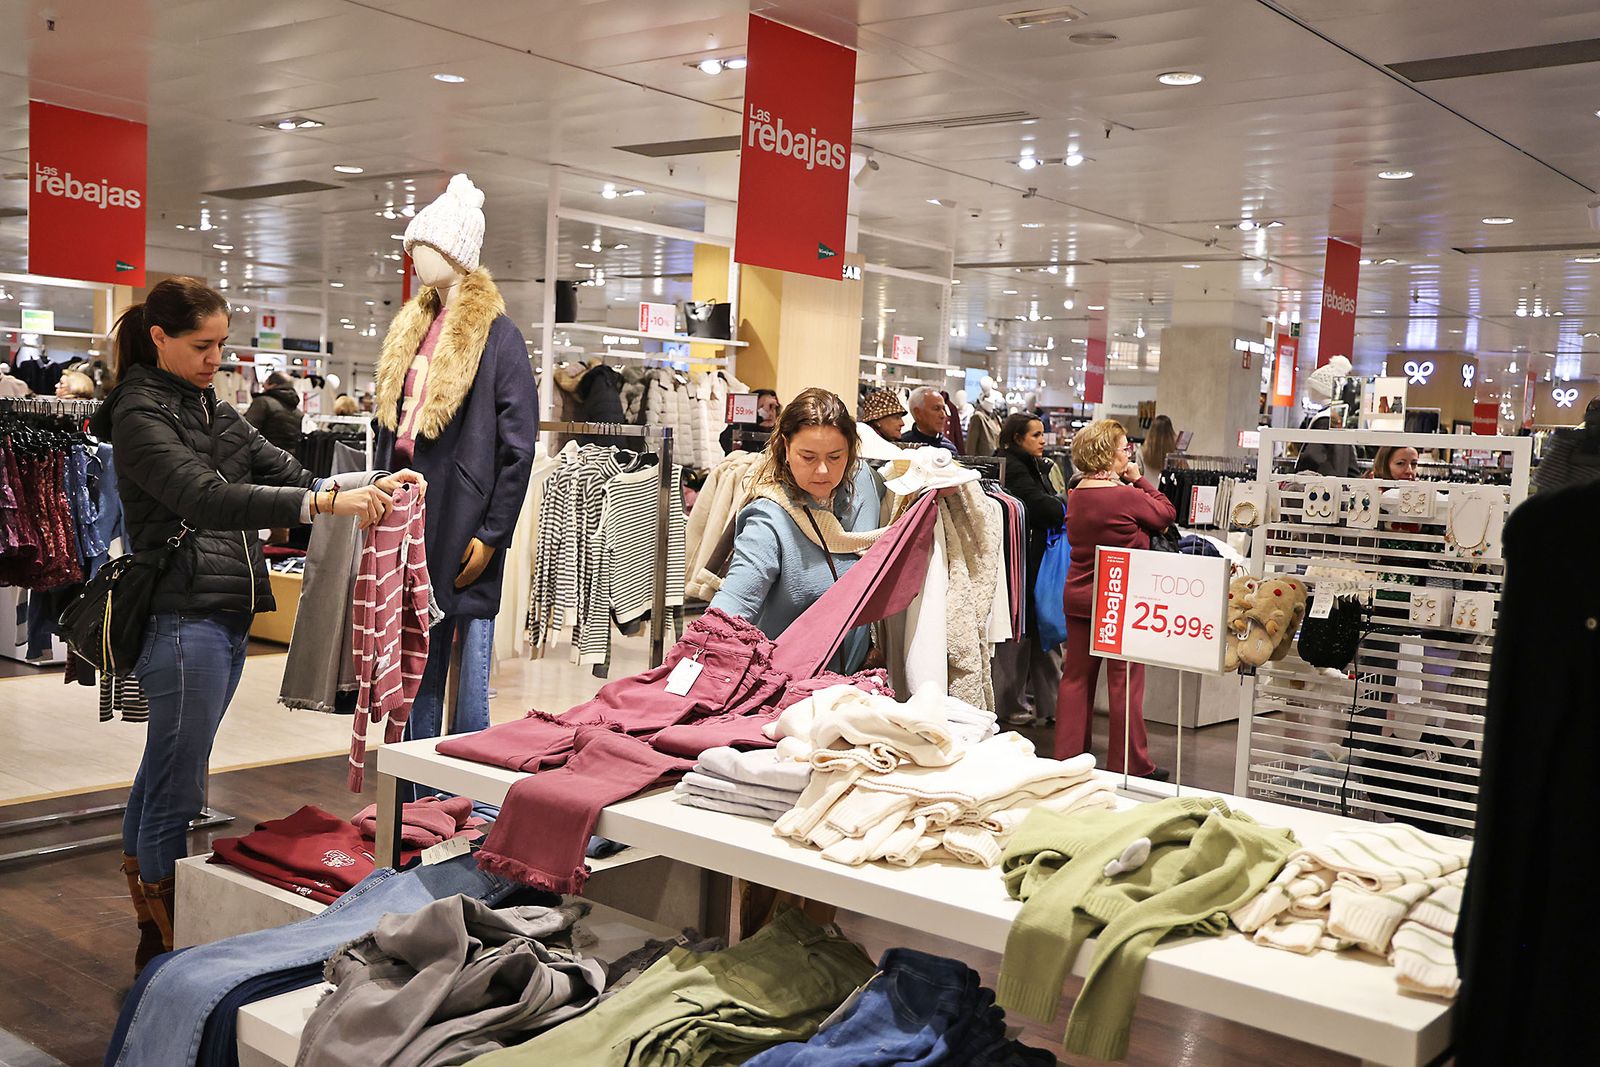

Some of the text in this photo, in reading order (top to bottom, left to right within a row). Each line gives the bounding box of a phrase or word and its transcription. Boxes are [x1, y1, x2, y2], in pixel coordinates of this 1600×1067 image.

[750, 103, 771, 122] Las
[748, 118, 846, 170] rebajas
[35, 162, 58, 176] Las
[35, 172, 141, 209] rebajas
[1323, 289, 1355, 316] rebajas
[1152, 574, 1205, 597] TODO
[1102, 566, 1124, 645] rebajas
[1131, 601, 1214, 640] 25,99€
